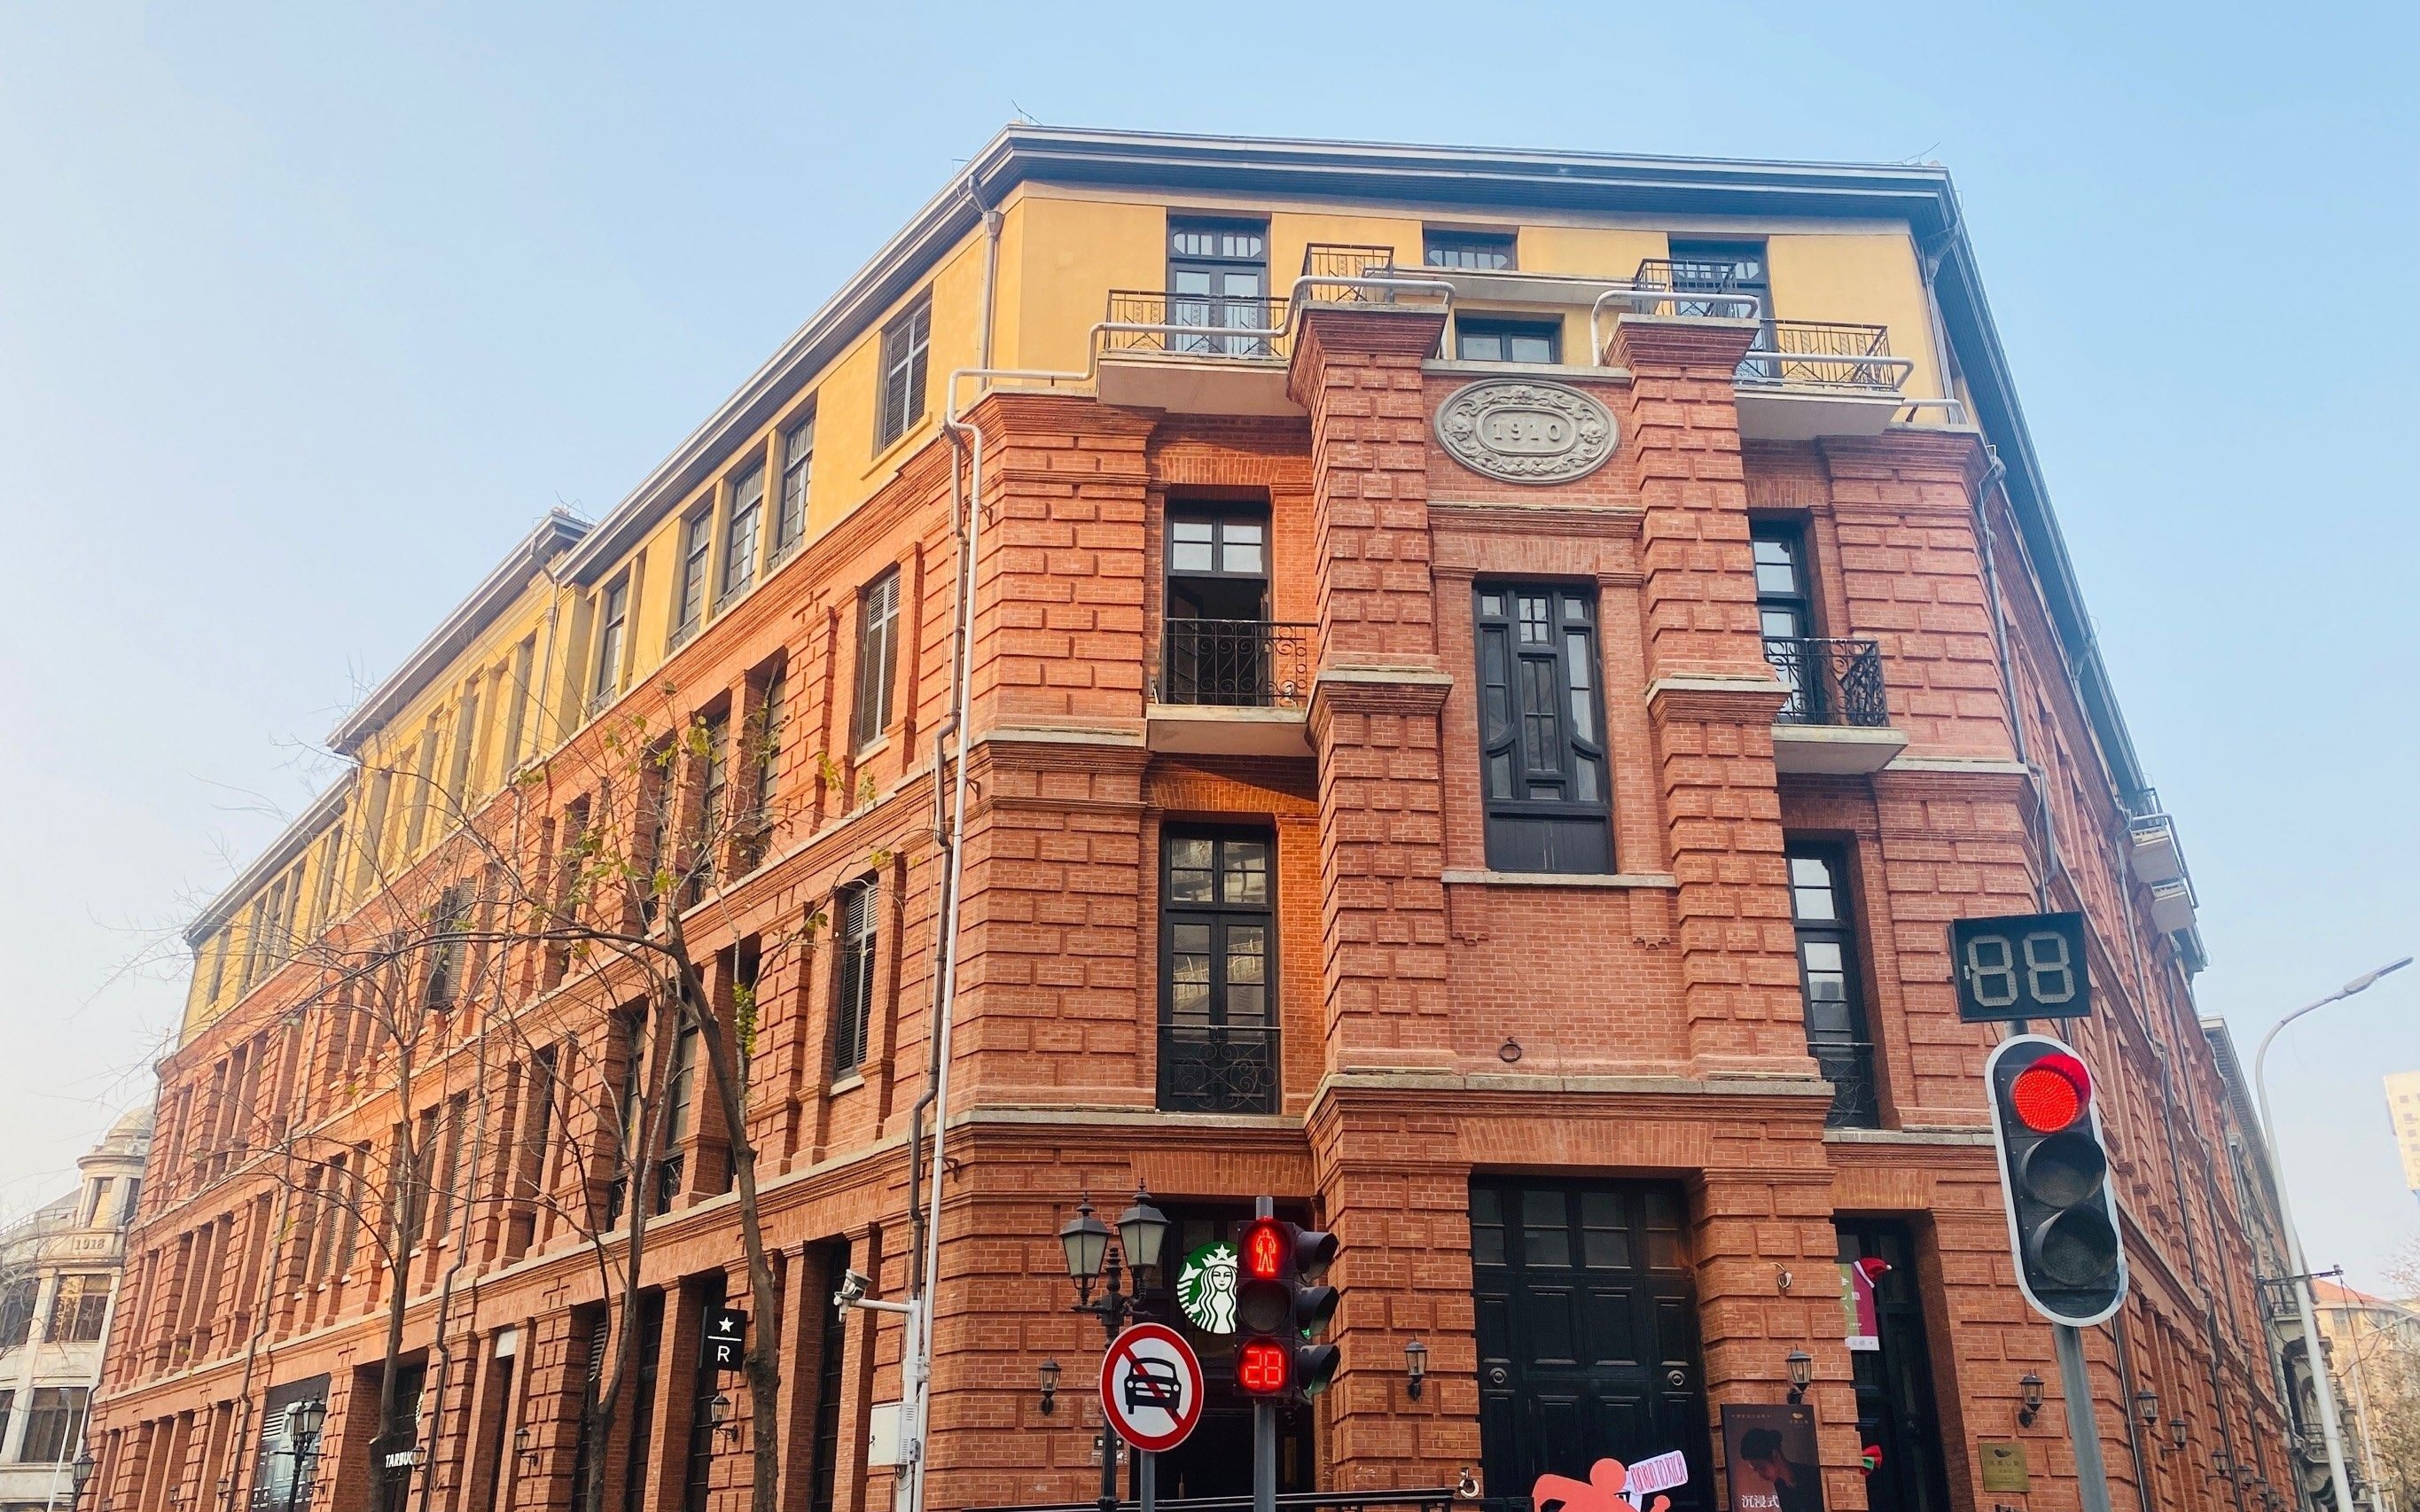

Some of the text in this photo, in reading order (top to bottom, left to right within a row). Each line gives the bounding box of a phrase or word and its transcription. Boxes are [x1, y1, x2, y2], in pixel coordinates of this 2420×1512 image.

[1493, 421, 1561, 441] 1910
[716, 1344, 730, 1363] R
[1245, 1349, 1282, 1384] 28
[385, 1451, 413, 1469] TARBUC
[1741, 1494, 1781, 1508] 沉浸式
